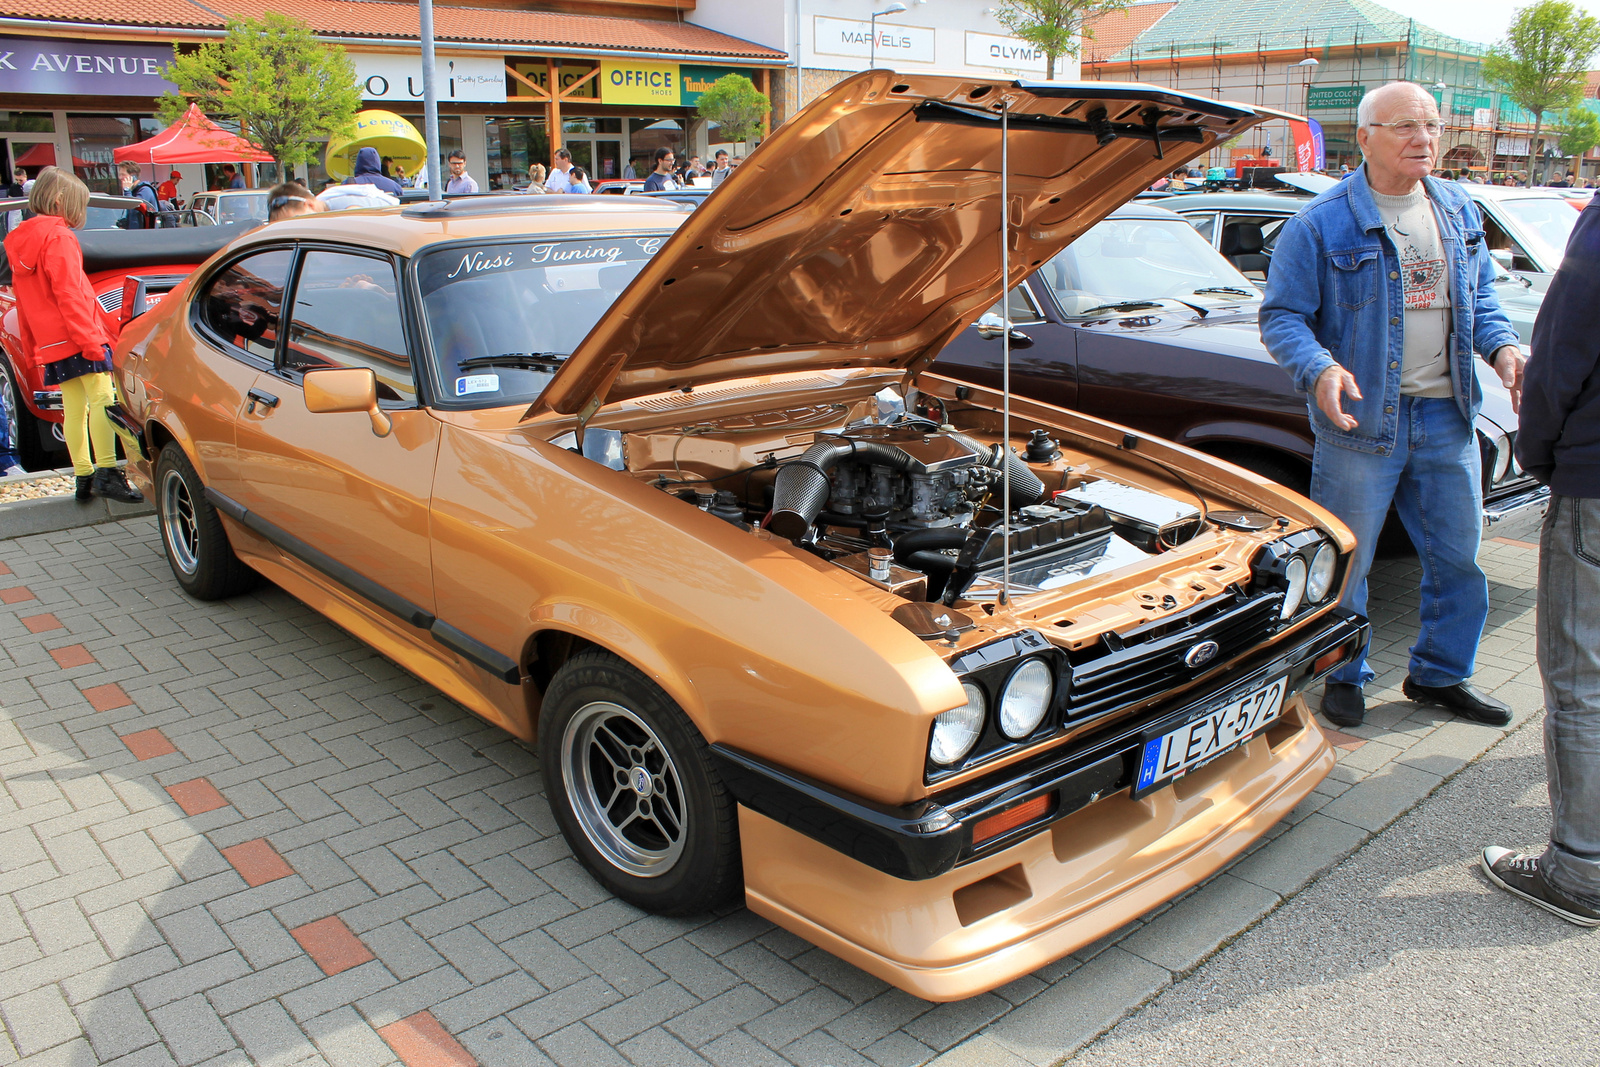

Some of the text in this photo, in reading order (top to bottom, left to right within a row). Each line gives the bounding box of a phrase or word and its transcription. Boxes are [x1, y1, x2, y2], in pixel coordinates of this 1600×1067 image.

[990, 44, 1043, 62] OLYMP
[30, 53, 160, 76] AVENUE
[526, 72, 585, 88] OFICE
[611, 69, 672, 88] OFFICE
[683, 76, 718, 93] Timber
[651, 88, 672, 96] SHOES
[448, 251, 513, 279] Nusi
[532, 243, 623, 263] Tuning
[1405, 292, 1437, 304] JEANS
[1414, 301, 1431, 309] 1989
[1161, 682, 1281, 775] LEX-572
[1142, 765, 1154, 783] H
